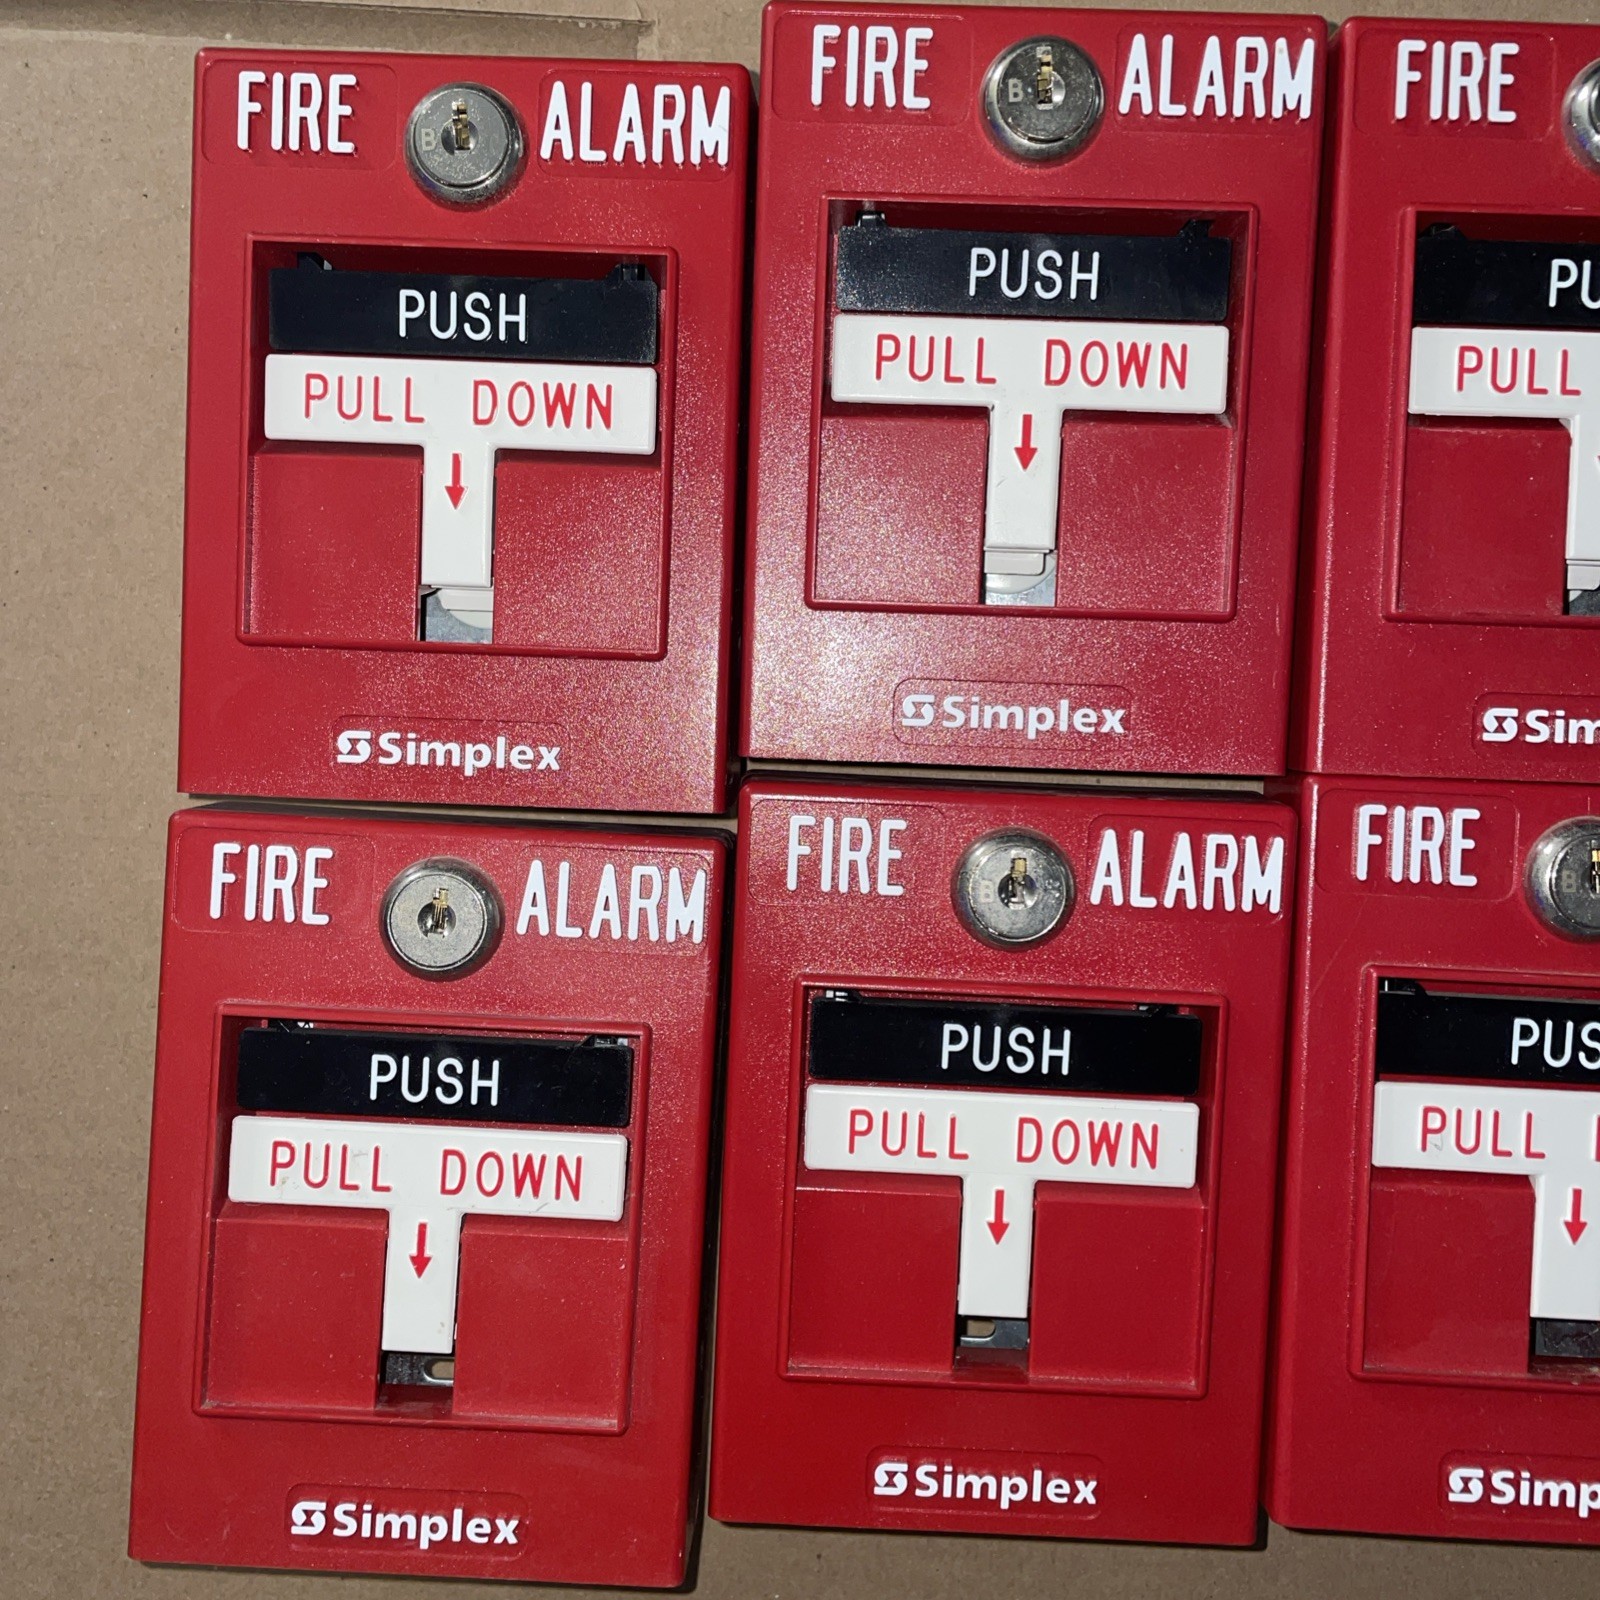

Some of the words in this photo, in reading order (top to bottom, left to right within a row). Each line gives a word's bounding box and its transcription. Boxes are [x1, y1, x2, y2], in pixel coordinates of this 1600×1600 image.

[811, 24, 934, 109] FIRE
[1118, 33, 1315, 119] ALARM
[1008, 78, 1023, 103] B
[1394, 39, 1520, 123] FIRE
[237, 70, 357, 153] FIRE
[539, 80, 731, 167] ALARM
[421, 128, 437, 152] B
[968, 247, 1100, 301] PUSH
[399, 289, 526, 342] PUSH
[875, 333, 997, 384] PULL
[1044, 338, 1189, 389] DOWN
[1457, 345, 1581, 396] PULL
[304, 372, 424, 423] PULL
[473, 379, 613, 429] DOWN
[942, 695, 1127, 740] Simplex
[378, 731, 561, 777] Simplex
[785, 810, 909, 897] FIRE
[1089, 828, 1284, 914] ALARM
[1355, 804, 1481, 887] FIRE
[209, 842, 334, 926] FIRE
[515, 859, 706, 944] ALARM
[980, 879, 995, 903] B
[1561, 870, 1577, 893] B
[941, 1023, 1071, 1076] PUSH
[369, 1053, 500, 1107] PUSH
[848, 1108, 969, 1160] PULL
[1016, 1116, 1159, 1169] DOWN
[1421, 1105, 1546, 1159] PULL
[270, 1140, 391, 1193] PULL
[440, 1148, 583, 1201] DOWN
[915, 1464, 1097, 1510] Simplex
[332, 1502, 519, 1550] Simplex
